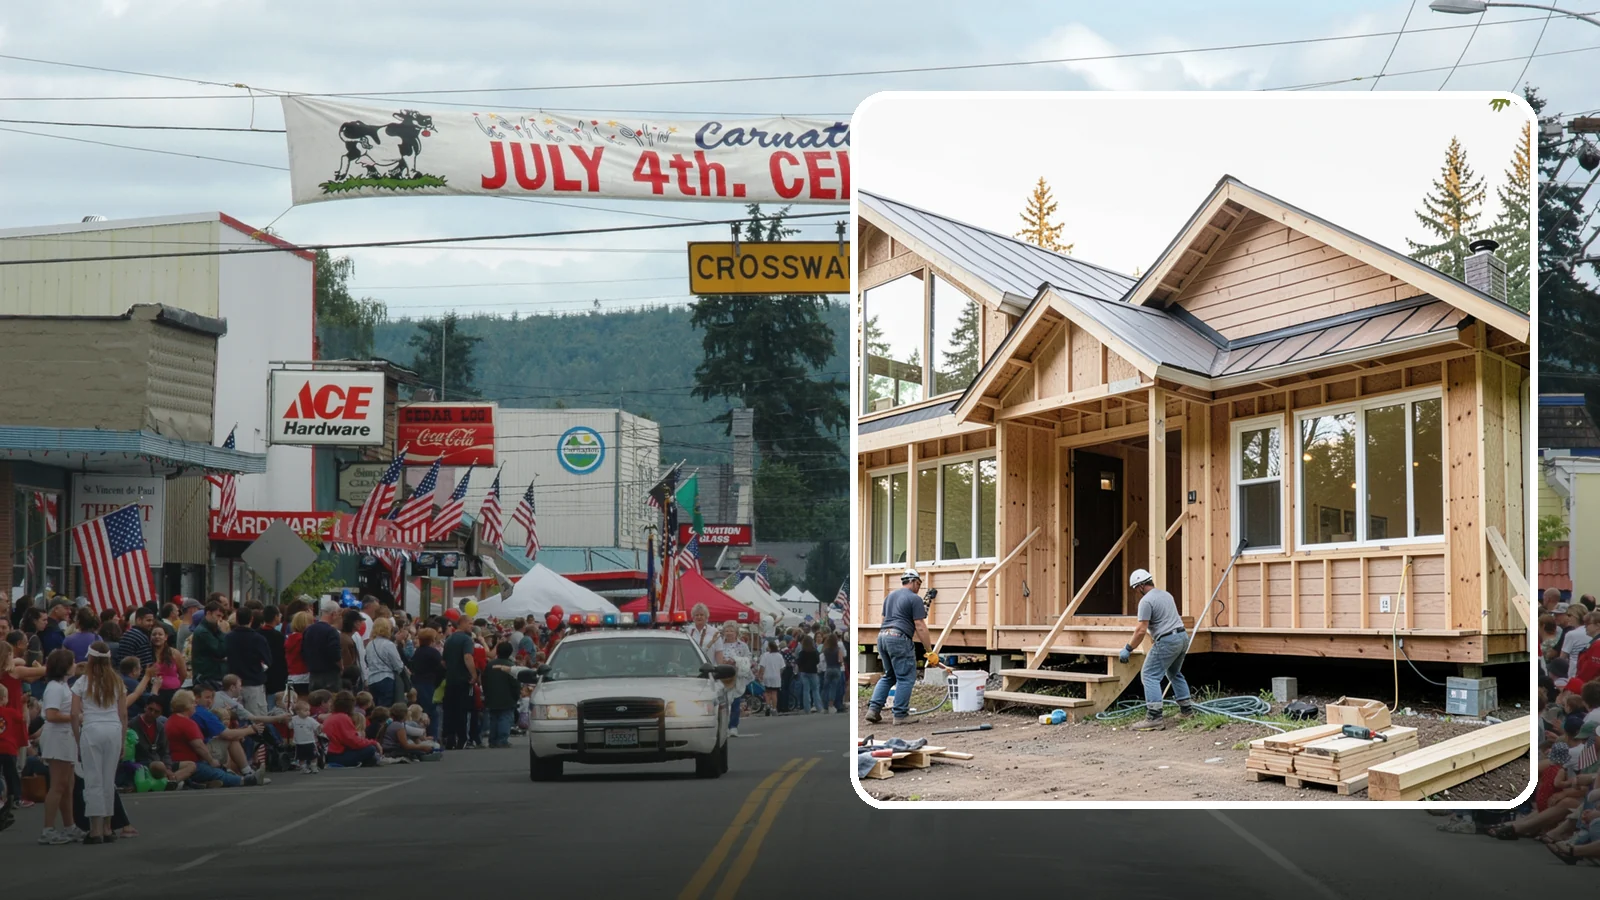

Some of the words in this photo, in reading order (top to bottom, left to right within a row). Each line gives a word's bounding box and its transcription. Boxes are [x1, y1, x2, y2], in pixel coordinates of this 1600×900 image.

[481, 141, 605, 193] JULY
[632, 150, 746, 198] 4th.
[697, 254, 850, 280] CROSSWA
[282, 380, 374, 420] ACE
[405, 409, 453, 422] CEDAR
[283, 421, 371, 436] Hardware
[96, 485, 124, 495] Vincent
[126, 486, 136, 495] de
[138, 486, 155, 495] Paul
[688, 526, 741, 535] CRNATION
[699, 535, 730, 543] GLASS
